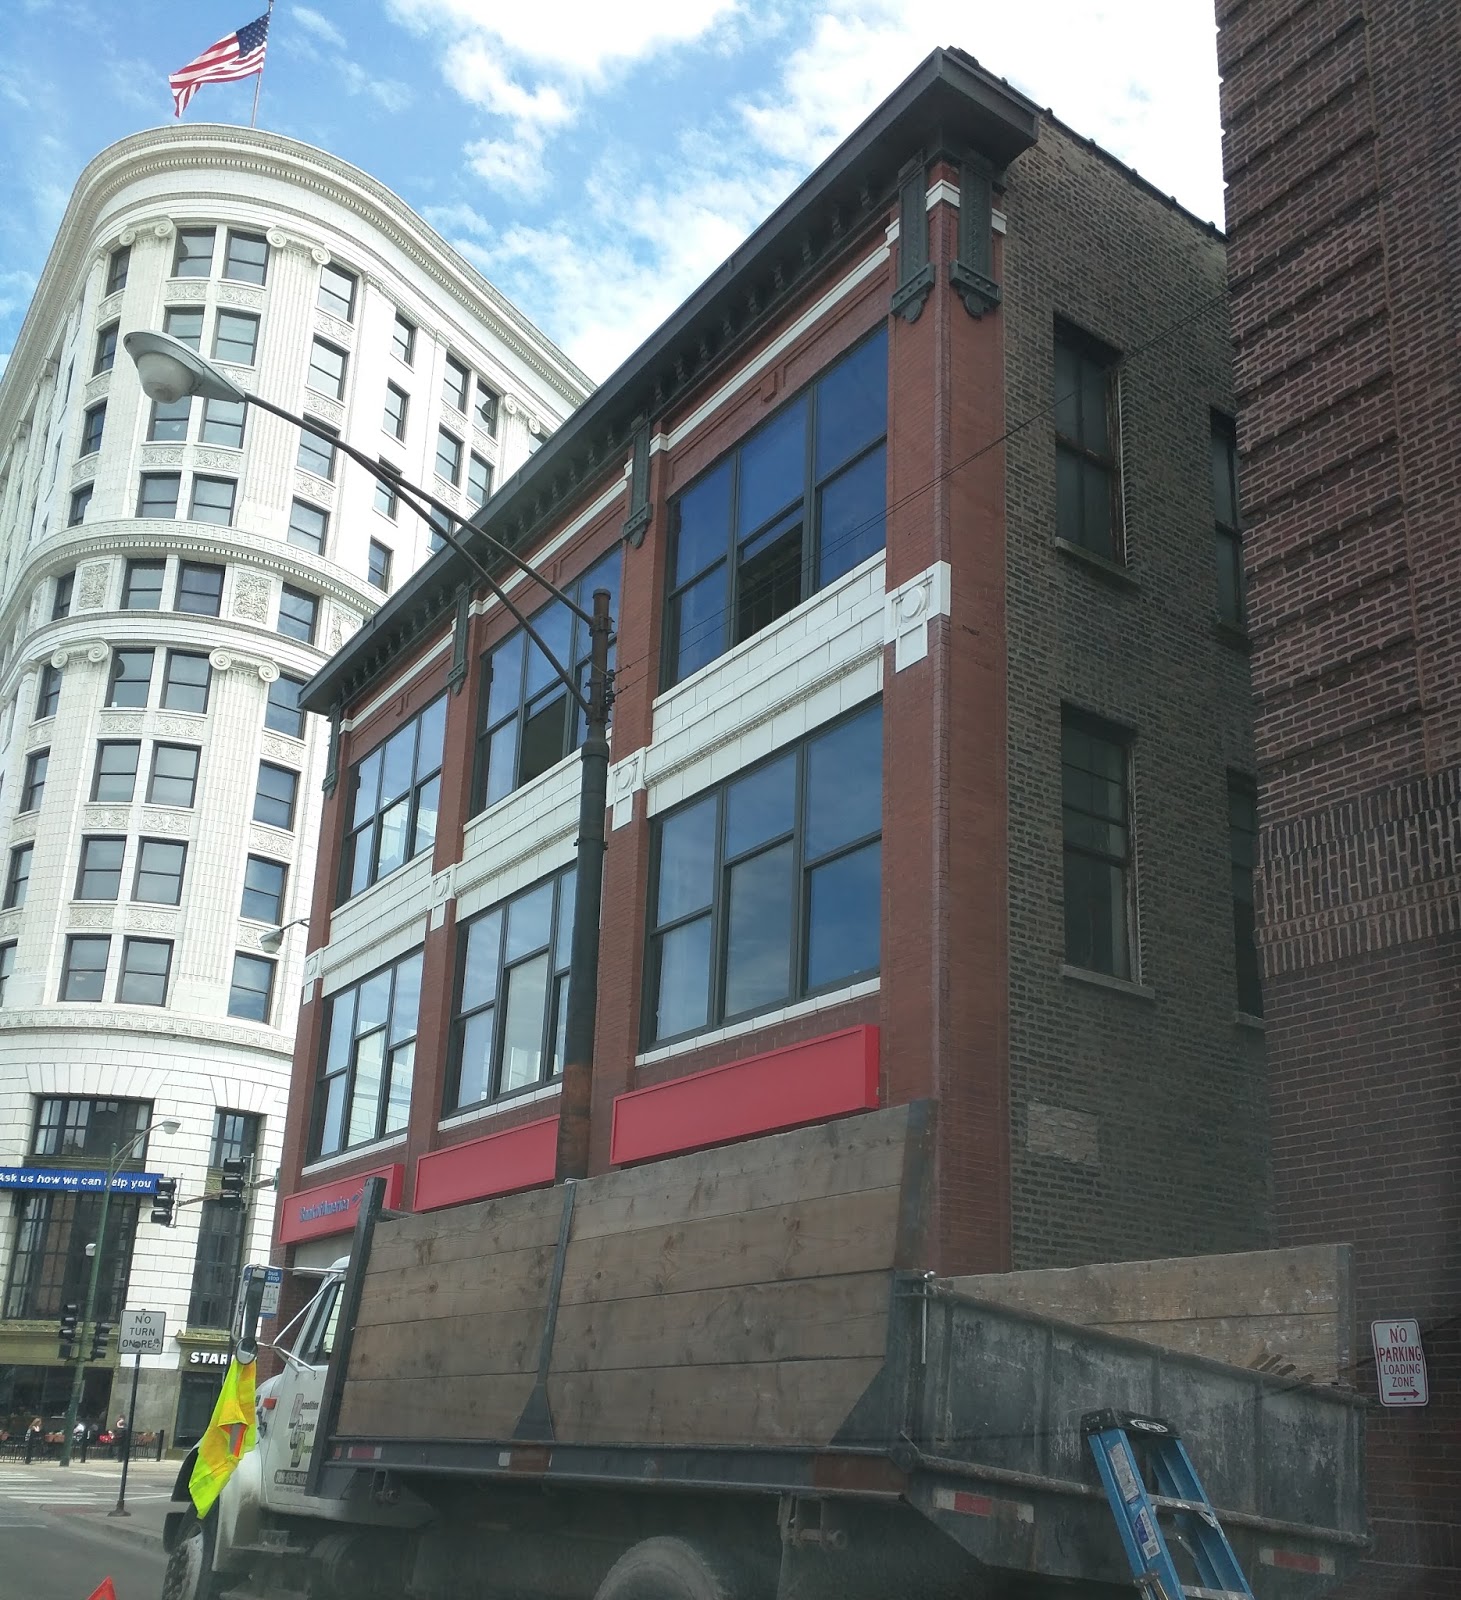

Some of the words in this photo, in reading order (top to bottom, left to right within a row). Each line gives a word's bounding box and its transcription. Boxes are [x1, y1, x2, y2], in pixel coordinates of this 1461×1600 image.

[20, 1175, 34, 1183] us
[36, 1174, 60, 1184] how
[63, 1176, 78, 1185] we
[81, 1178, 101, 1186] can
[131, 1180, 152, 1189] you
[135, 1315, 152, 1324] NO
[129, 1327, 156, 1336] TURN
[1389, 1327, 1408, 1344] NO
[190, 1352, 229, 1365] STAR
[1378, 1346, 1422, 1362] PARKING
[1383, 1363, 1421, 1375] LOADING
[1392, 1376, 1415, 1388] ZONE
